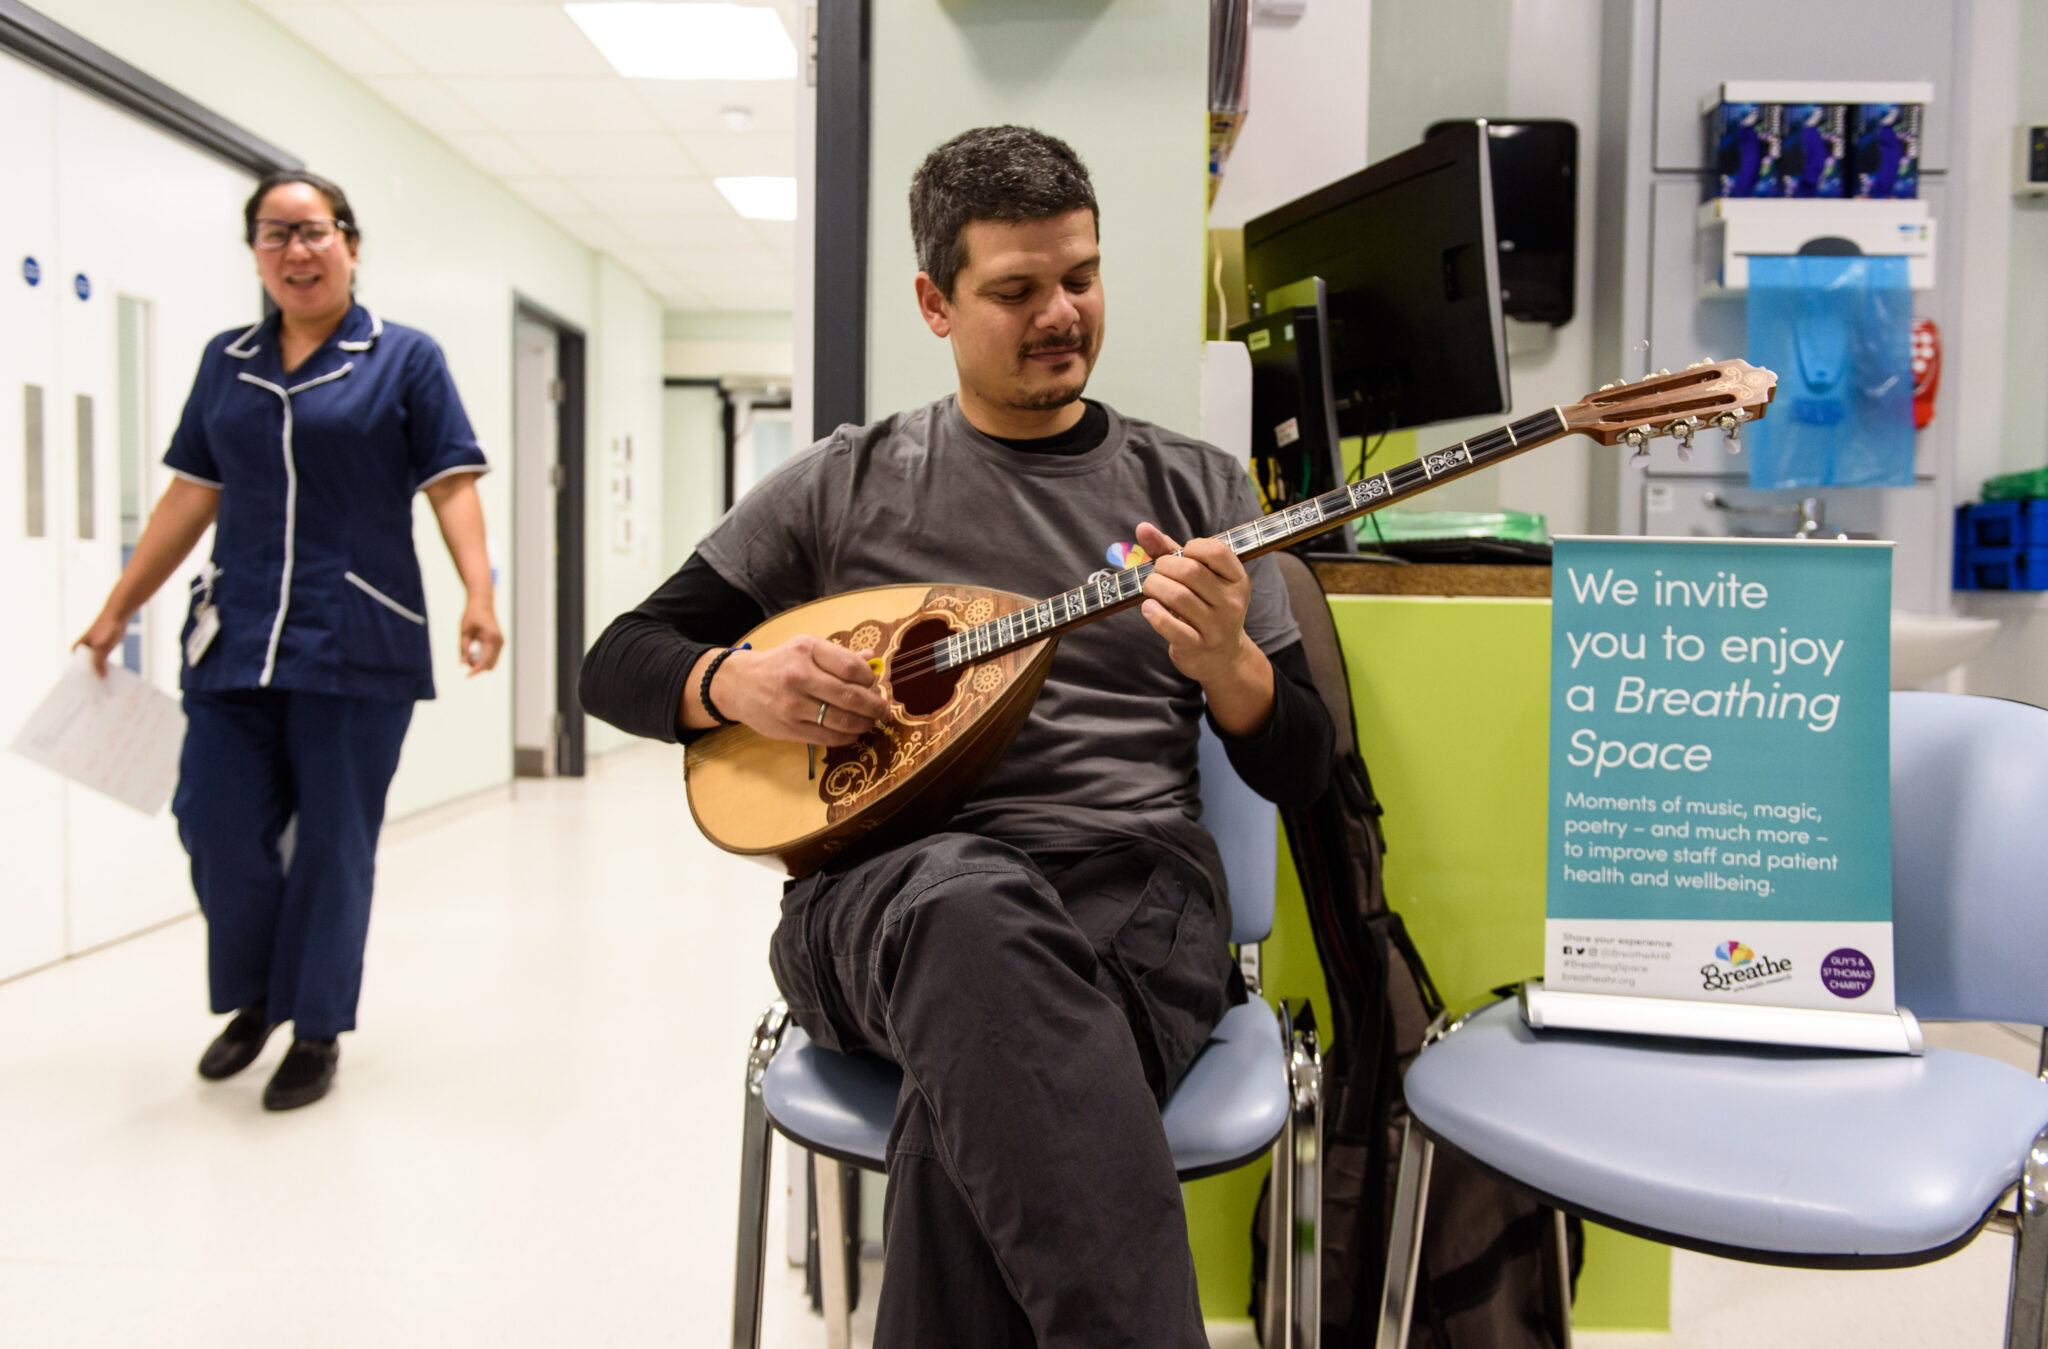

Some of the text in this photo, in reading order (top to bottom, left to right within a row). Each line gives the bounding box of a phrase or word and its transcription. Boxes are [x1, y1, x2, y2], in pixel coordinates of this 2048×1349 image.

[1568, 568, 1768, 609] We invite
[1567, 626, 1844, 676] you to enjoy
[1566, 676, 1840, 732] a Breathing
[1567, 729, 1712, 778] Space
[1565, 792, 1822, 823] Moments of music, magic,
[1564, 818, 1628, 838] poetry
[1651, 821, 1690, 838] and
[1695, 824, 1750, 841] much
[1757, 829, 1810, 845] more
[1564, 842, 1839, 872] to improve staff and patient
[1564, 864, 1775, 897] health and wellbeing.
[1563, 933, 1592, 942] Share
[1595, 936, 1615, 945] your
[1700, 955, 1792, 991] Breathe
[1830, 956, 1865, 967] GUY'S &
[1829, 979, 1867, 991] CHARITY
